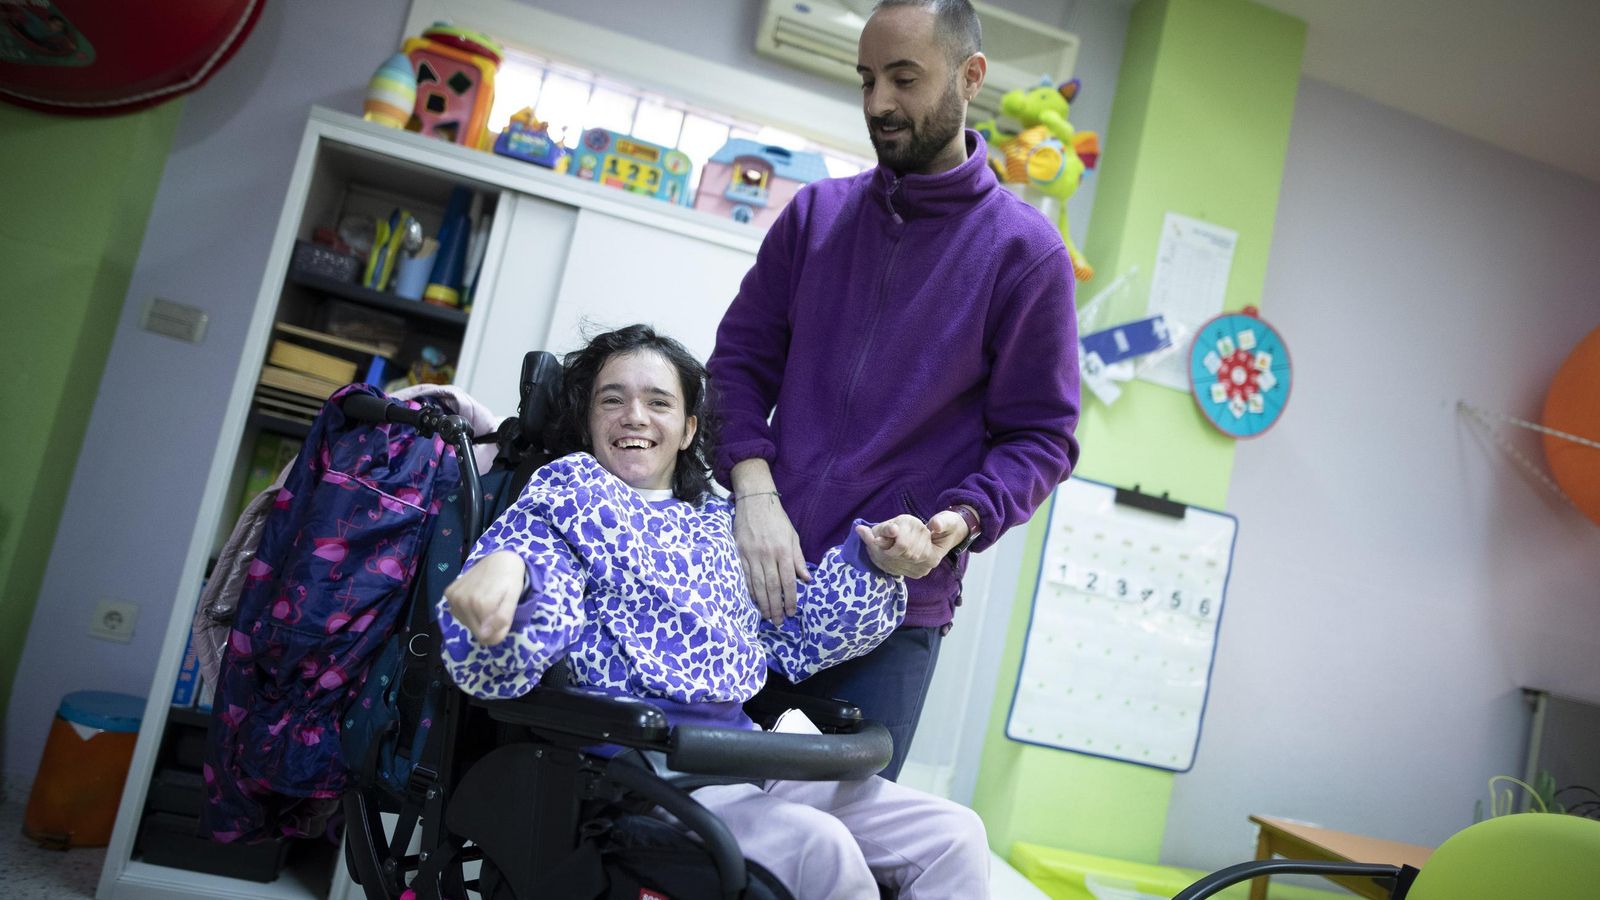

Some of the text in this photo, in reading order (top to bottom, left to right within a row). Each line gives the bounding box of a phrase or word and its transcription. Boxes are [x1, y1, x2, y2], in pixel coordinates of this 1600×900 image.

[606, 159, 660, 186] 1 2 3
[1059, 564, 1067, 578] 1
[1086, 572, 1098, 590] 2
[1116, 579, 1127, 596] 3
[1170, 590, 1182, 609] 5
[1199, 598, 1211, 616] 6
